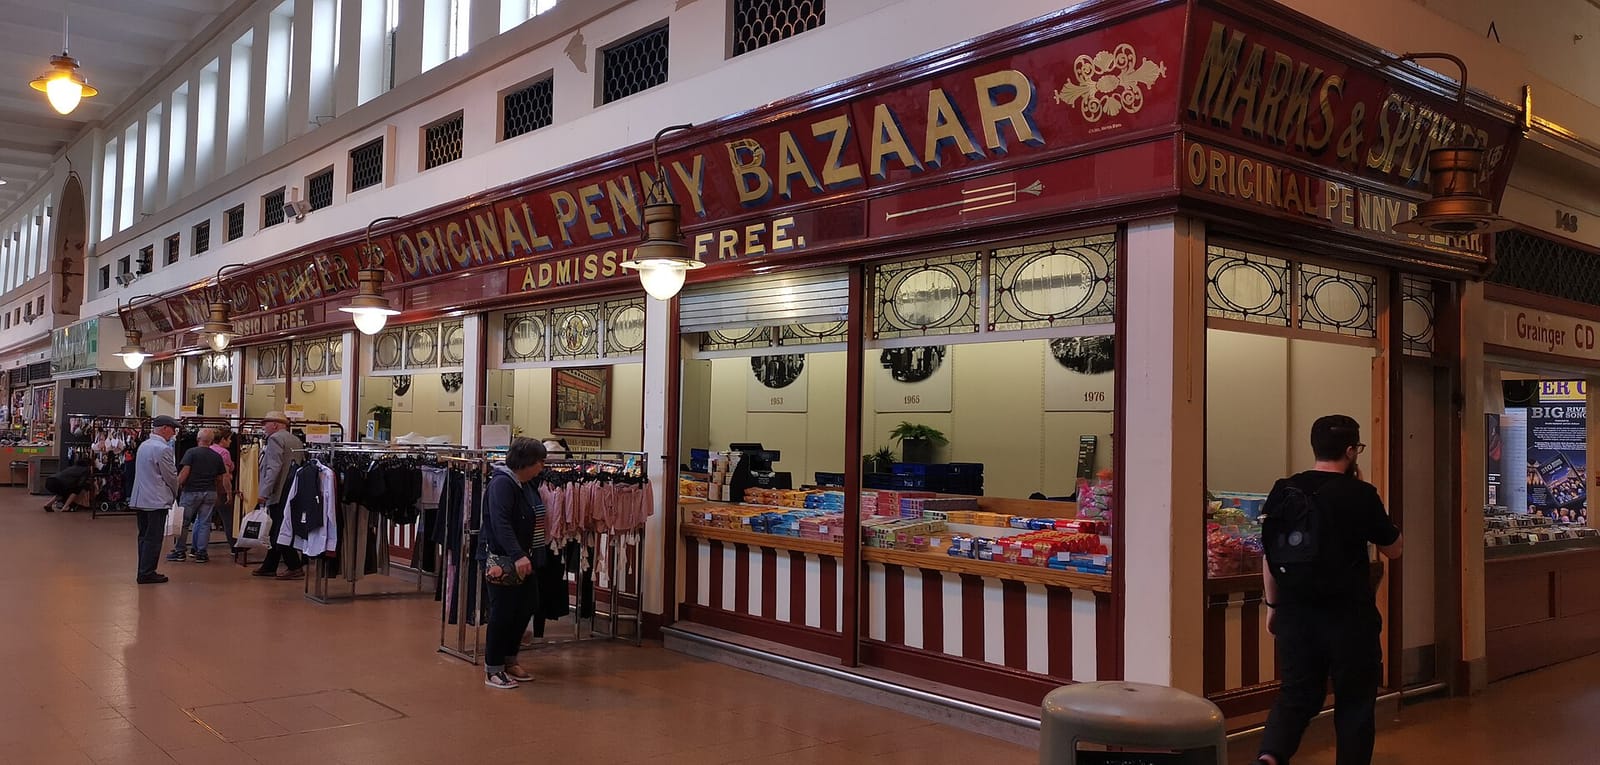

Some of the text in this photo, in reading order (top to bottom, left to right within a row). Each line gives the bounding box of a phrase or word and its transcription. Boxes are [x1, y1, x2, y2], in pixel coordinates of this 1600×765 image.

[1187, 20, 1345, 153] MARKS
[1337, 101, 1366, 162] &
[1367, 93, 1489, 185] SPEN
[400, 203, 553, 276] ORIGINAL
[725, 69, 1042, 204] BAZAAR
[1188, 142, 1319, 217] ORIGINAL
[1325, 180, 1401, 235] PENNY
[522, 216, 806, 291] ADMISSI FREE.
[1516, 312, 1595, 352] Grainger CD
[1084, 391, 1105, 402] 1976
[1531, 407, 1564, 418] BIG
[1539, 381, 1571, 396] ER
